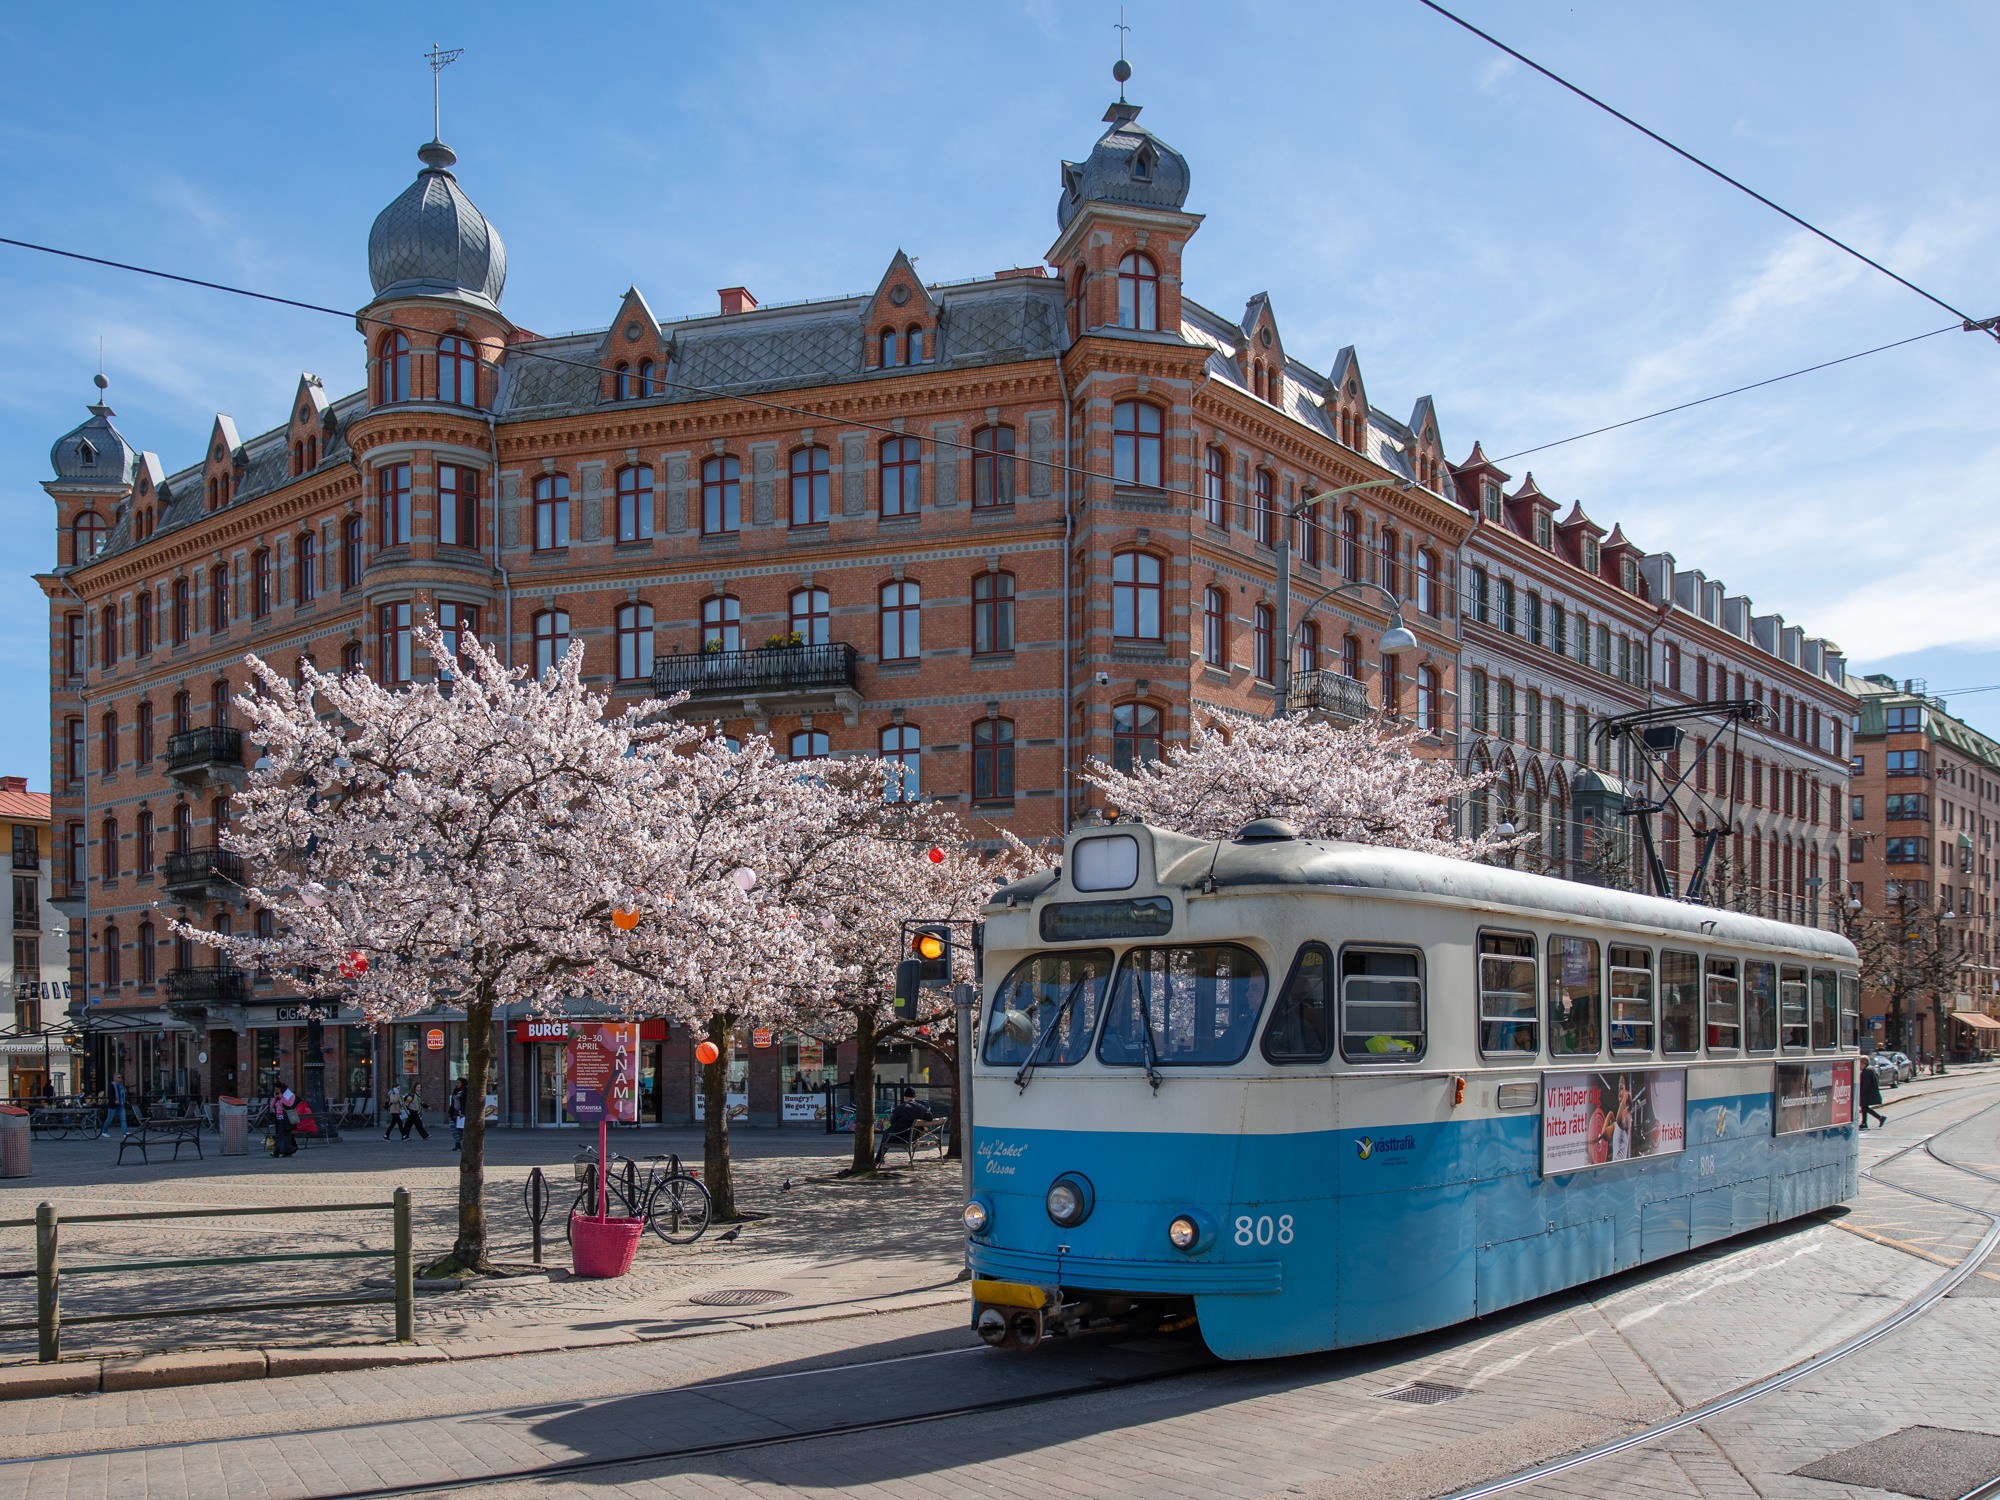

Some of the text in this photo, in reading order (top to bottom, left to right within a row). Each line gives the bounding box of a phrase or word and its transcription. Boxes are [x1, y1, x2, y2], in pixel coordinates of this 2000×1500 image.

[613, 1031, 629, 1113] HANAMI
[785, 1095, 814, 1103] Hungry?
[795, 1103, 805, 1111] got
[806, 1103, 819, 1111] you
[1547, 1083, 1602, 1112] Vi hjälper dig
[1546, 1113, 1588, 1137] hitta rätt!
[1661, 1122, 1682, 1142] friskis
[977, 1141, 994, 1159] Leif
[1374, 1134, 1416, 1153] västtrafik
[986, 1159, 1016, 1175] Olsson
[1701, 1154, 1715, 1176] 808
[1234, 1214, 1294, 1246] 808
